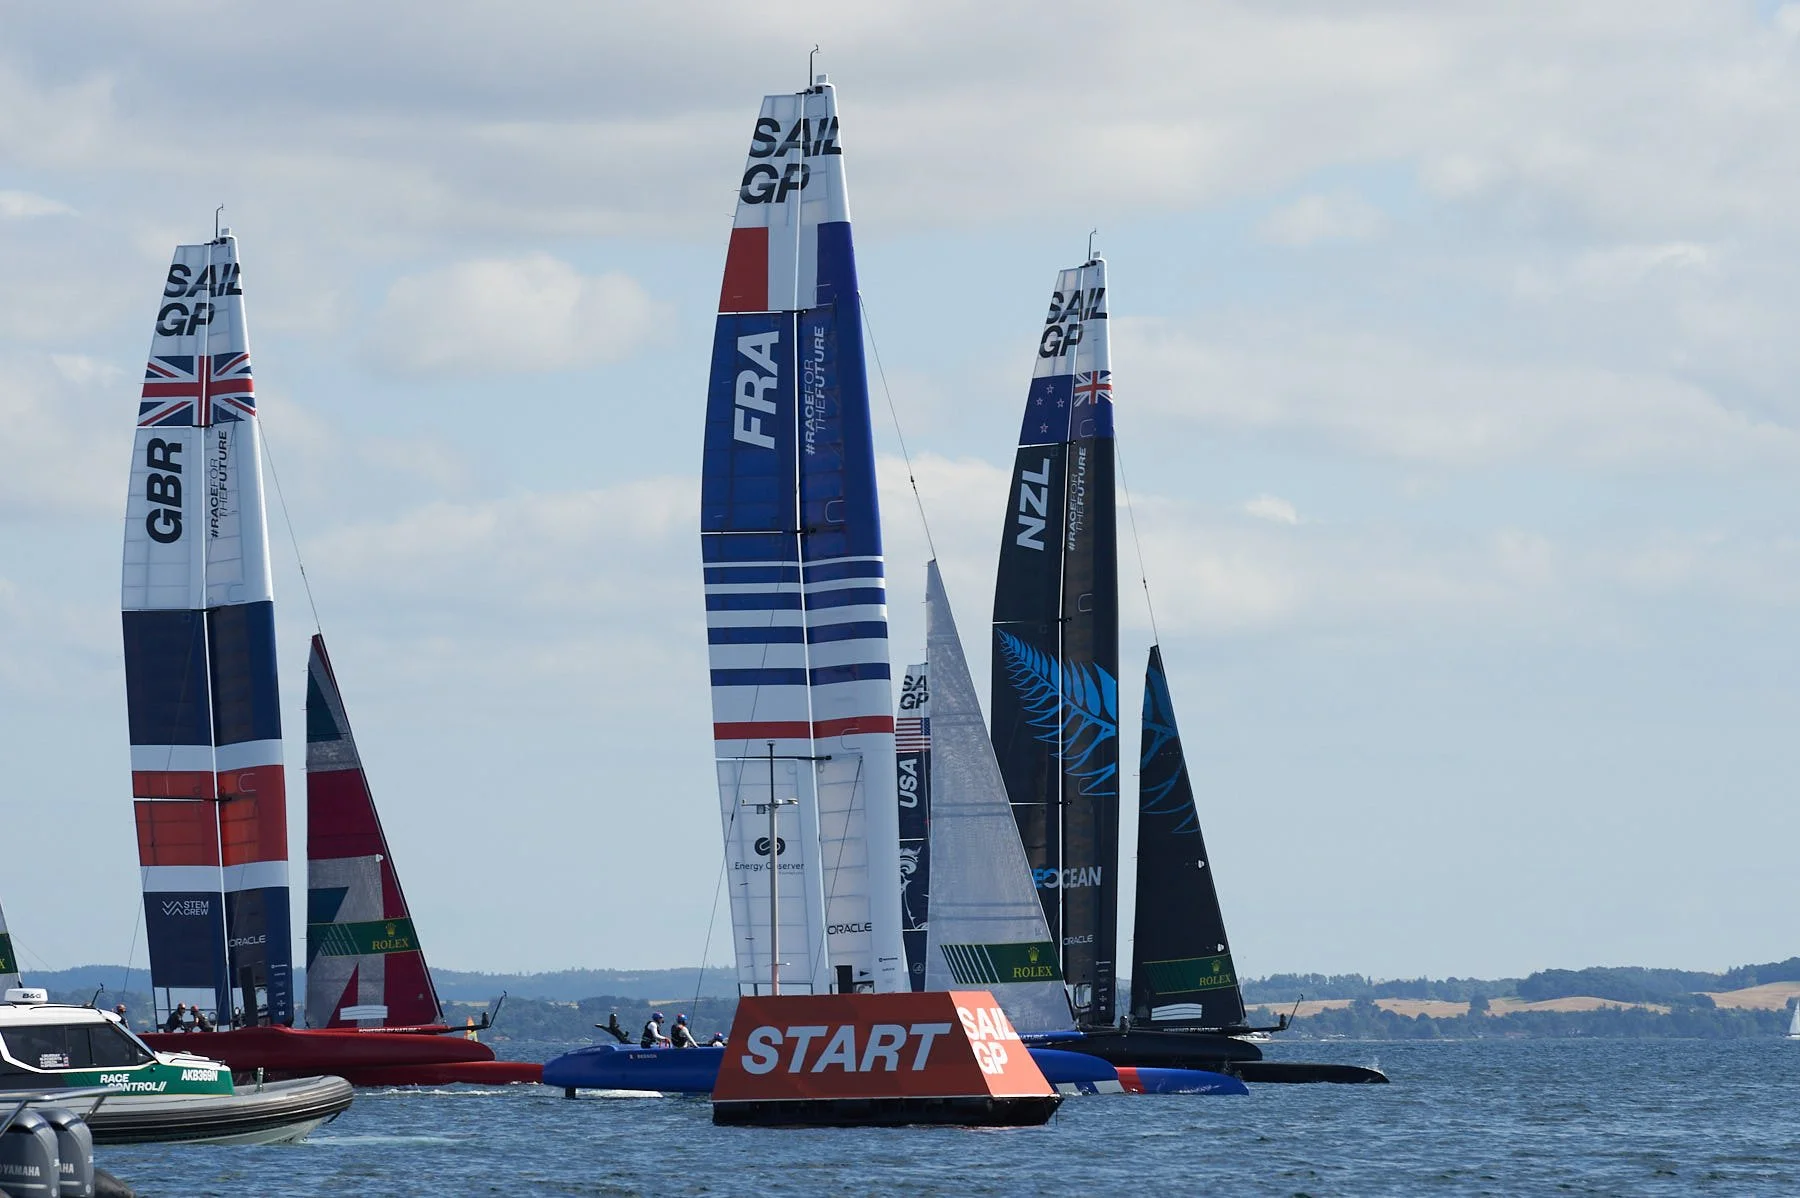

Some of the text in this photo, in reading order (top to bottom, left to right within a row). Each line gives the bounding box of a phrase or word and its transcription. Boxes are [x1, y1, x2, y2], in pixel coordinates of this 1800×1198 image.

[749, 116, 842, 158] SAIL
[740, 163, 810, 204] GP
[163, 262, 243, 298] SAIL
[155, 302, 215, 337] GP
[1045, 287, 1108, 325] SAIL
[1039, 324, 1084, 359] GP
[734, 331, 780, 450] FRA
[814, 326, 827, 432] THEFUTURE
[803, 359, 816, 456] #RACEFOR
[146, 437, 183, 544] GBR
[1016, 458, 1051, 551] NZL
[902, 674, 929, 692] SA
[899, 691, 929, 710] GP
[899, 758, 918, 809] USA
[735, 861, 805, 872] Energy Oserver
[183, 900, 209, 908] STEM
[183, 908, 209, 916] CREW
[228, 934, 267, 948] ORACLE
[371, 938, 409, 951] ROLEX
[827, 922, 873, 935] ORACLE
[1062, 934, 1094, 946] ORACLE
[1013, 966, 1053, 978] ROLEX
[1199, 973, 1231, 986] ROLEX
[956, 1006, 1021, 1041] SAIL
[741, 1022, 952, 1075] START
[971, 1041, 1009, 1075] GP
[100, 1073, 130, 1083] RACE
[181, 1069, 218, 1082] AKB369N
[3, 1163, 40, 1177] YAMAHA
